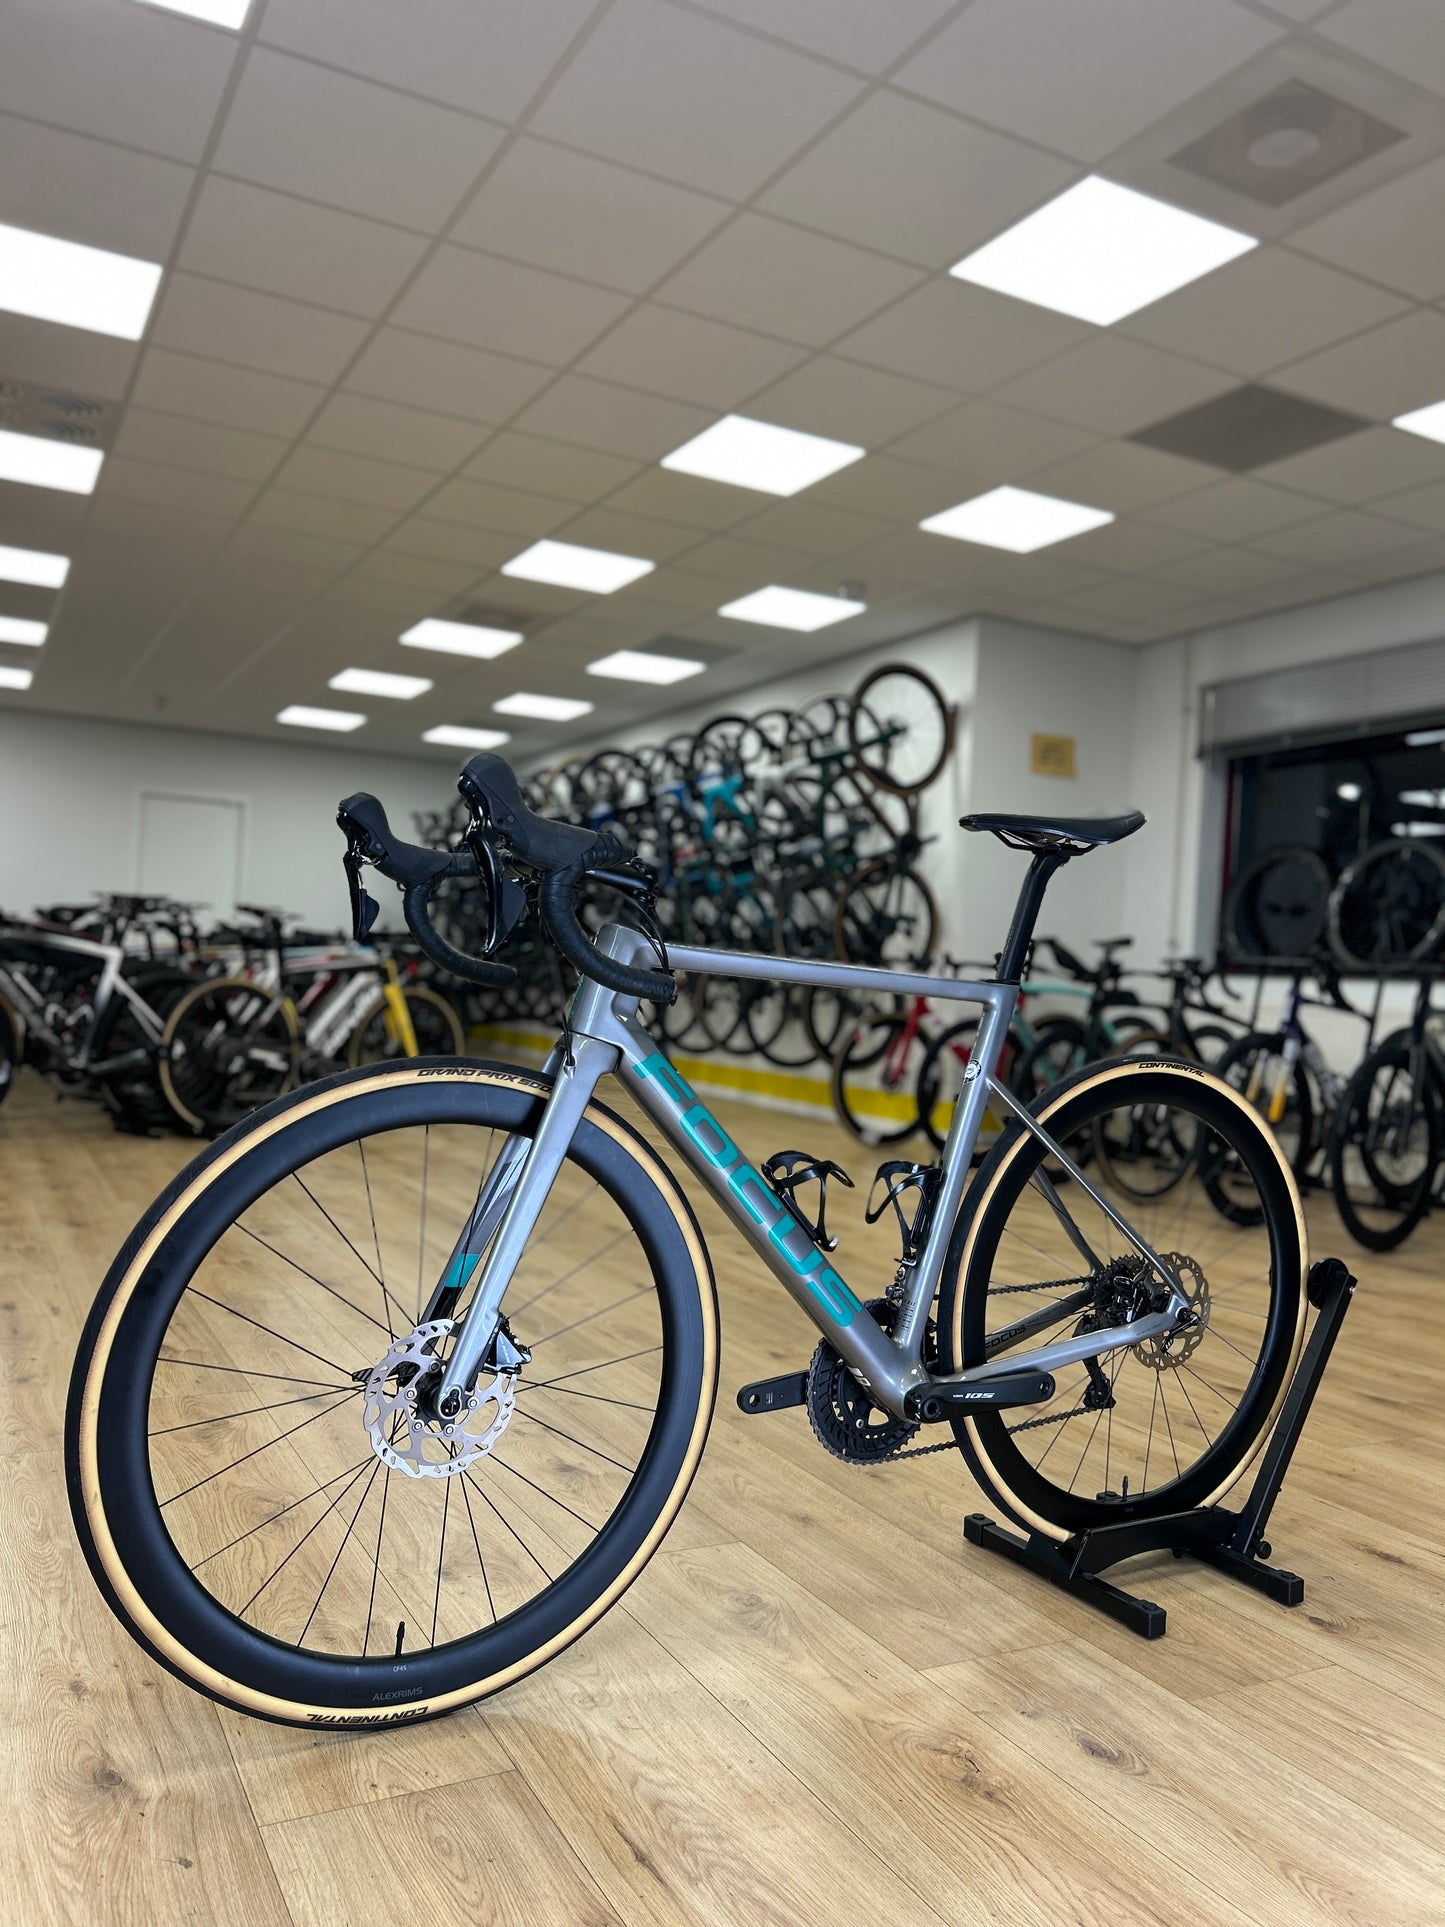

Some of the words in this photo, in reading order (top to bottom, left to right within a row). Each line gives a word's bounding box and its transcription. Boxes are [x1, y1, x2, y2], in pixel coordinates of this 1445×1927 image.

[1138, 1062, 1205, 1078] CONTINENTAL
[416, 1068, 475, 1077] GRAND
[475, 1070, 519, 1083] PRIX
[517, 1076, 553, 1094] 500
[632, 1052, 863, 1328] FOCUS
[372, 1686, 424, 1701] ALEXRIMS
[306, 1705, 429, 1724] CONTINENTAL
